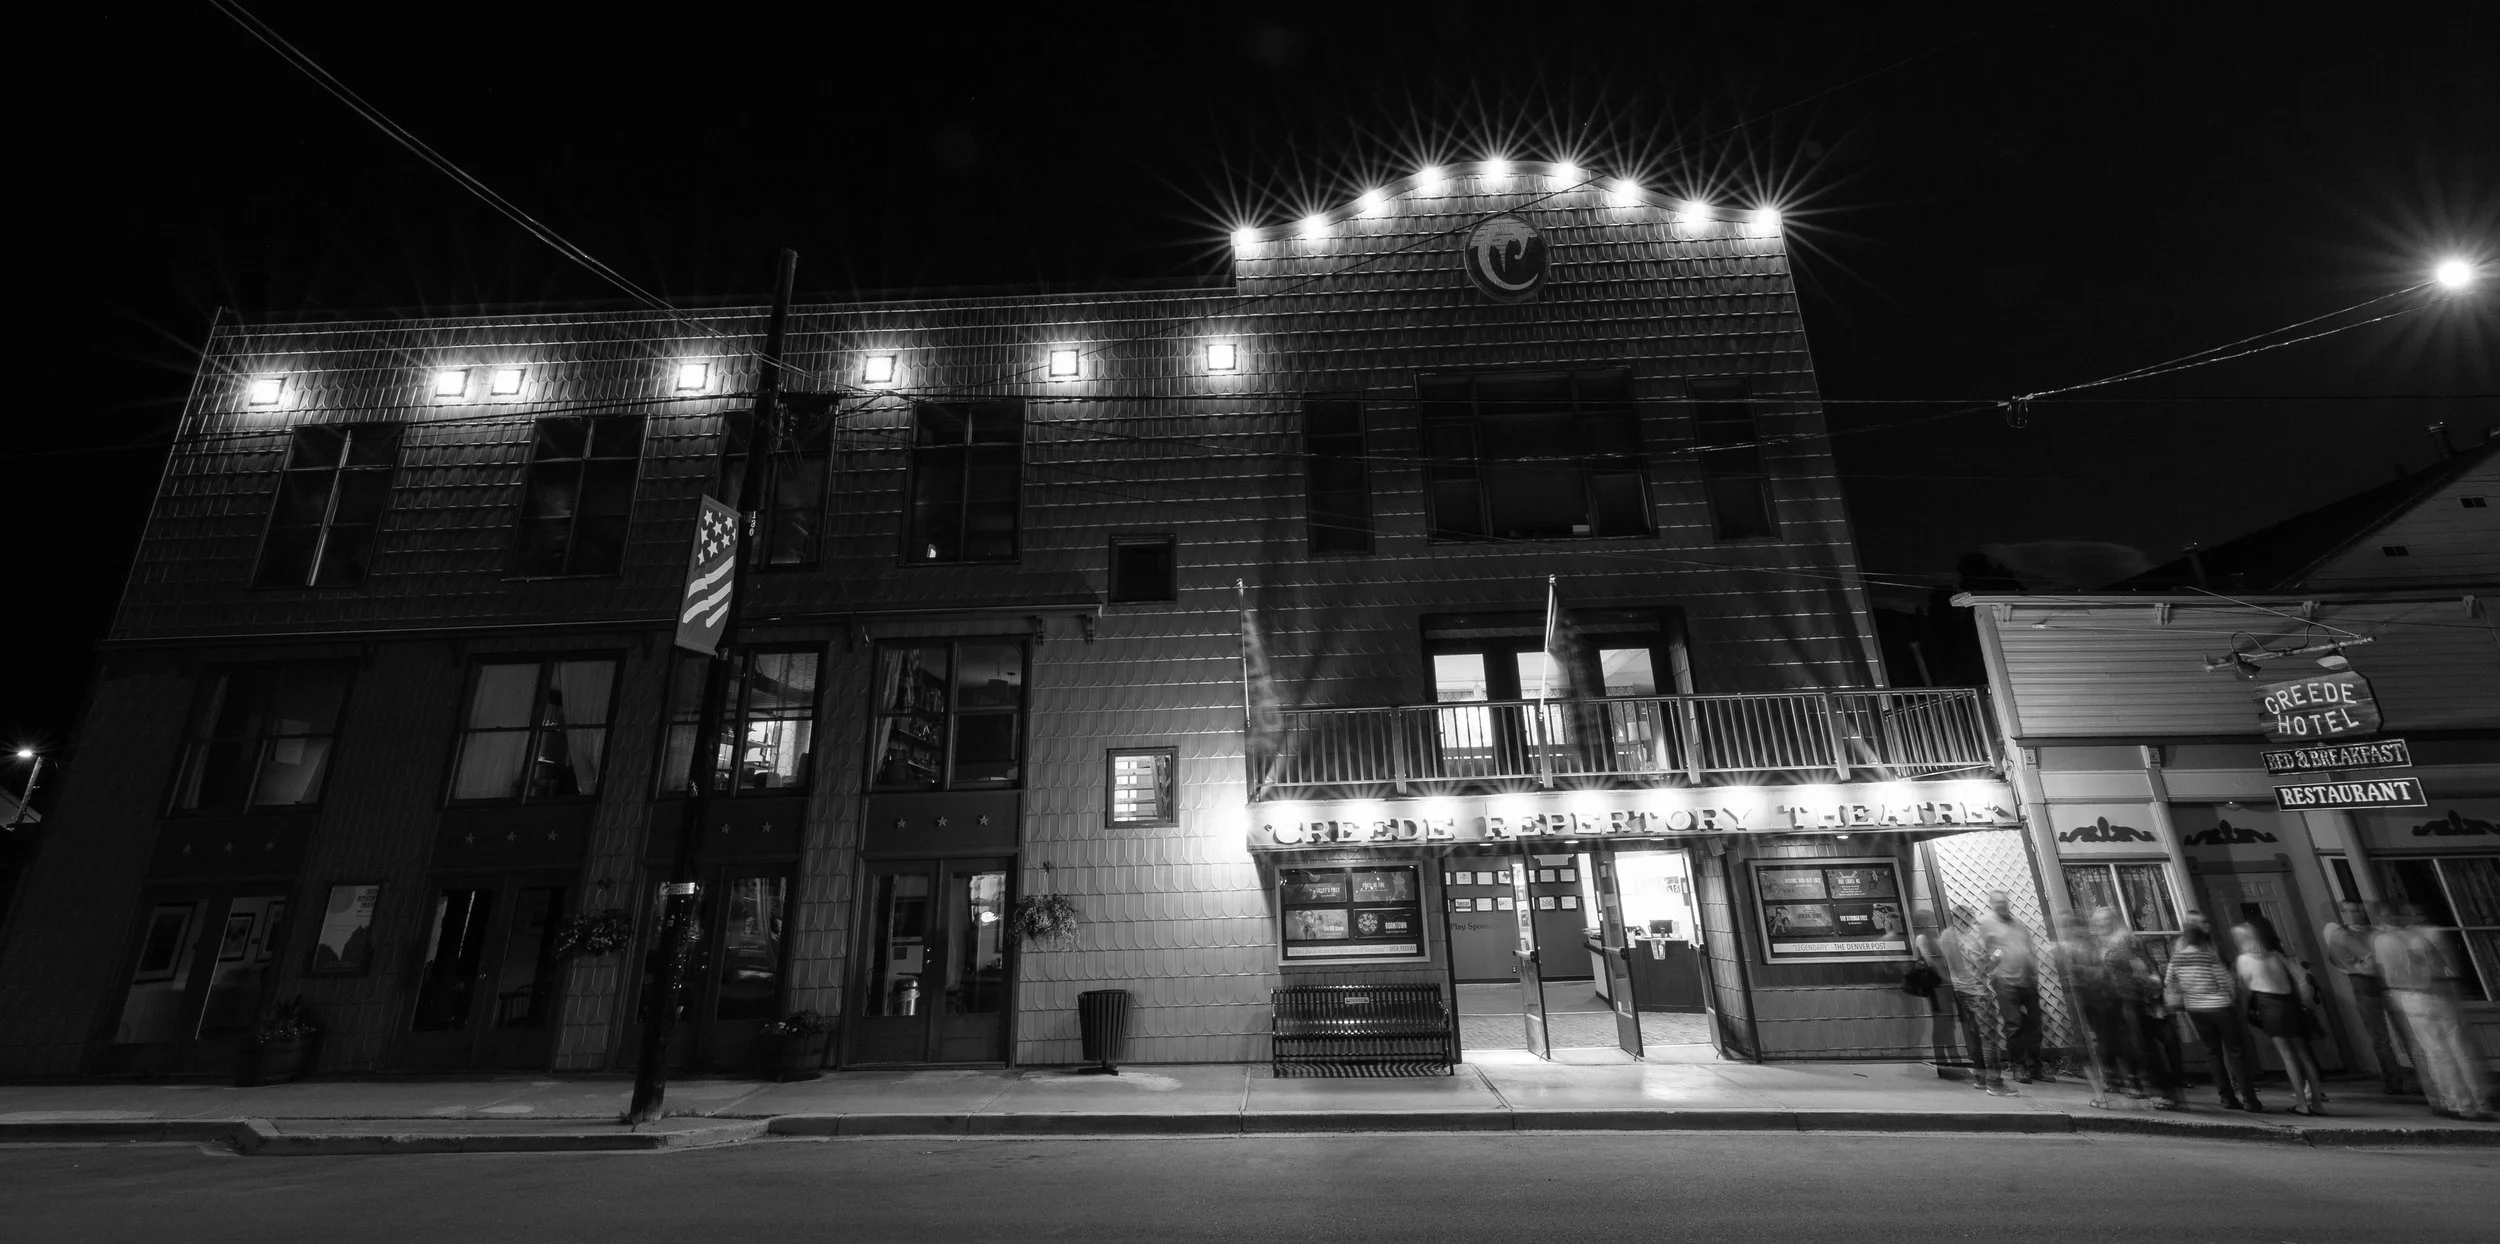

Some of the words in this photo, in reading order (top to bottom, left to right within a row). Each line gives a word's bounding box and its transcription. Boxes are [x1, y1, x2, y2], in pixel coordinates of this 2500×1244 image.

[2265, 683, 2357, 714] CREEDE
[2278, 708, 2360, 736] HOTEL
[2265, 752, 2295, 771] BED
[2295, 750, 2310, 768] &
[2310, 743, 2404, 769] BREAKFAST
[2280, 781, 2412, 806] RESTAURANT
[1273, 814, 1455, 844] CREEDE
[1483, 807, 1752, 841] REPERTORY
[1782, 800, 1993, 829] THEATRE
[1833, 943, 1846, 951] THE
[1846, 942, 1870, 951] DENVER
[1871, 942, 1887, 950] POST
